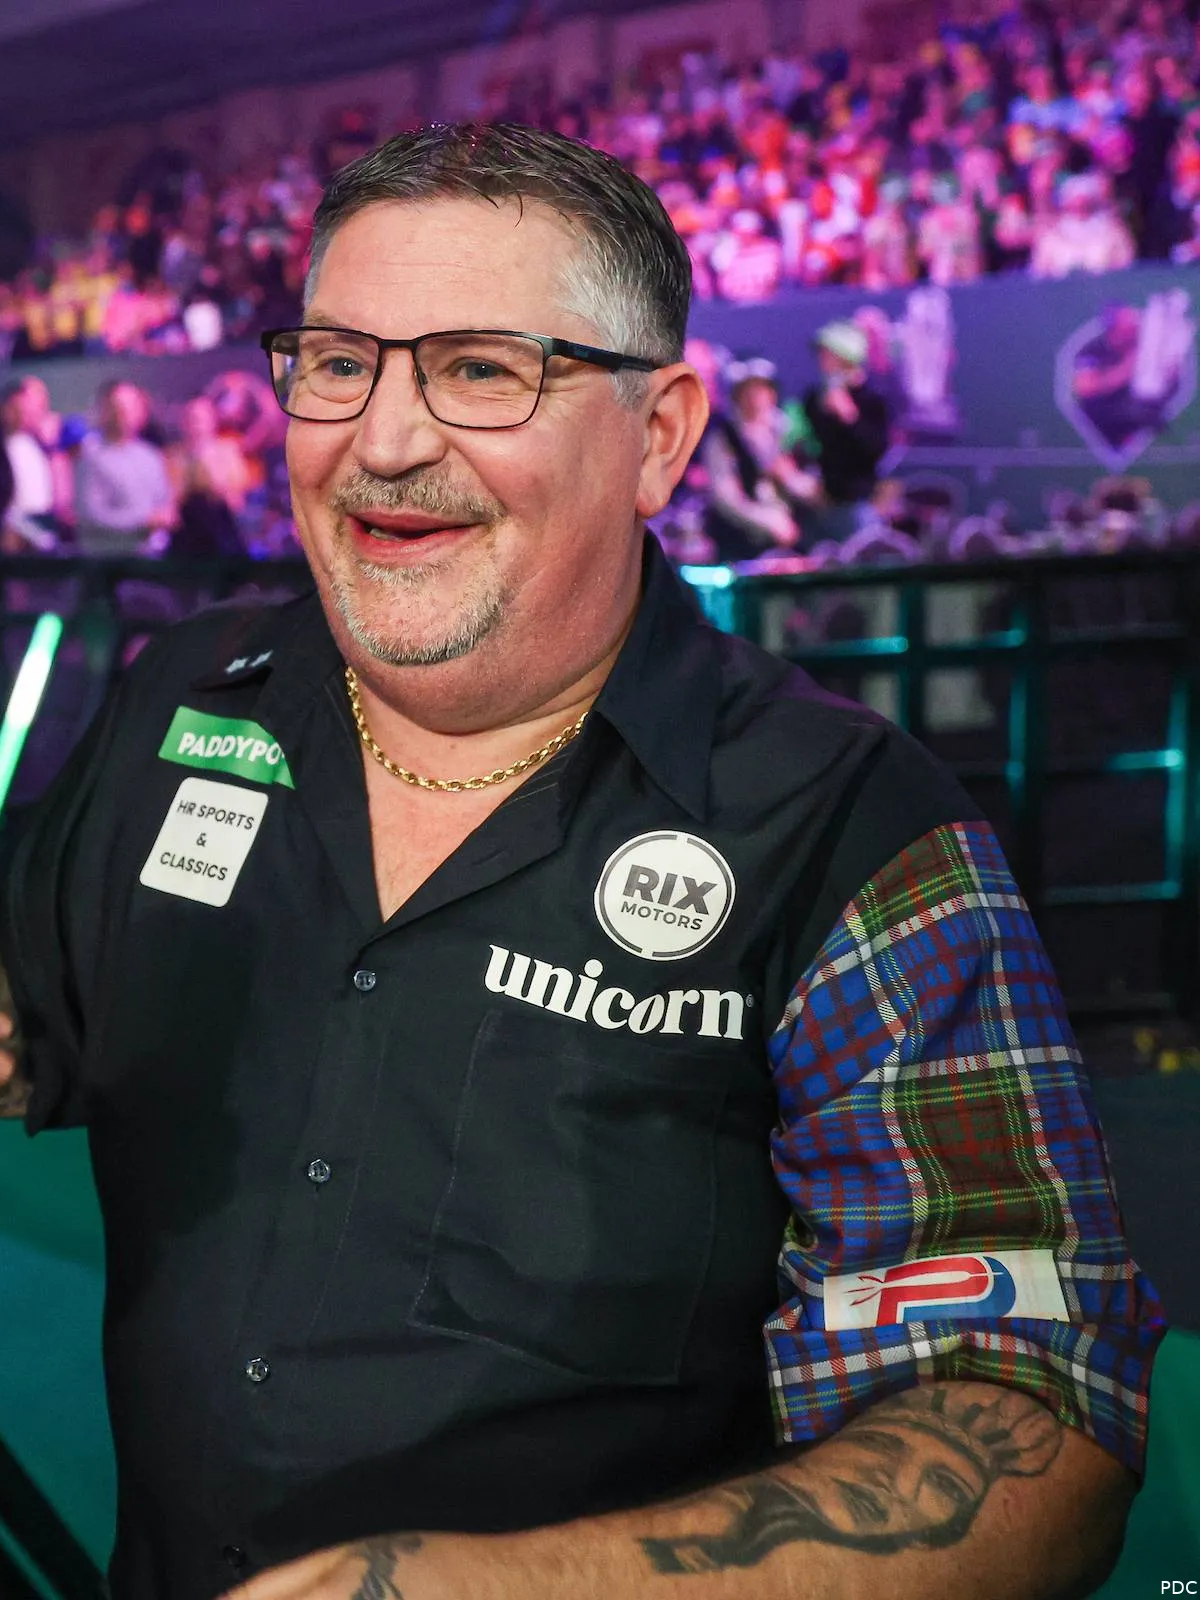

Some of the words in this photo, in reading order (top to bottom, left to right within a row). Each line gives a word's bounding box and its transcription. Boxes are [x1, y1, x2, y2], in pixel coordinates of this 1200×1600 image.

[177, 732, 285, 765] PADDYPO
[176, 800, 195, 816] HR
[197, 804, 255, 830] SPORTS
[196, 832, 207, 848] &
[160, 852, 229, 881] CLASSICS
[622, 864, 718, 916] RIX
[620, 901, 704, 931] MOTORS
